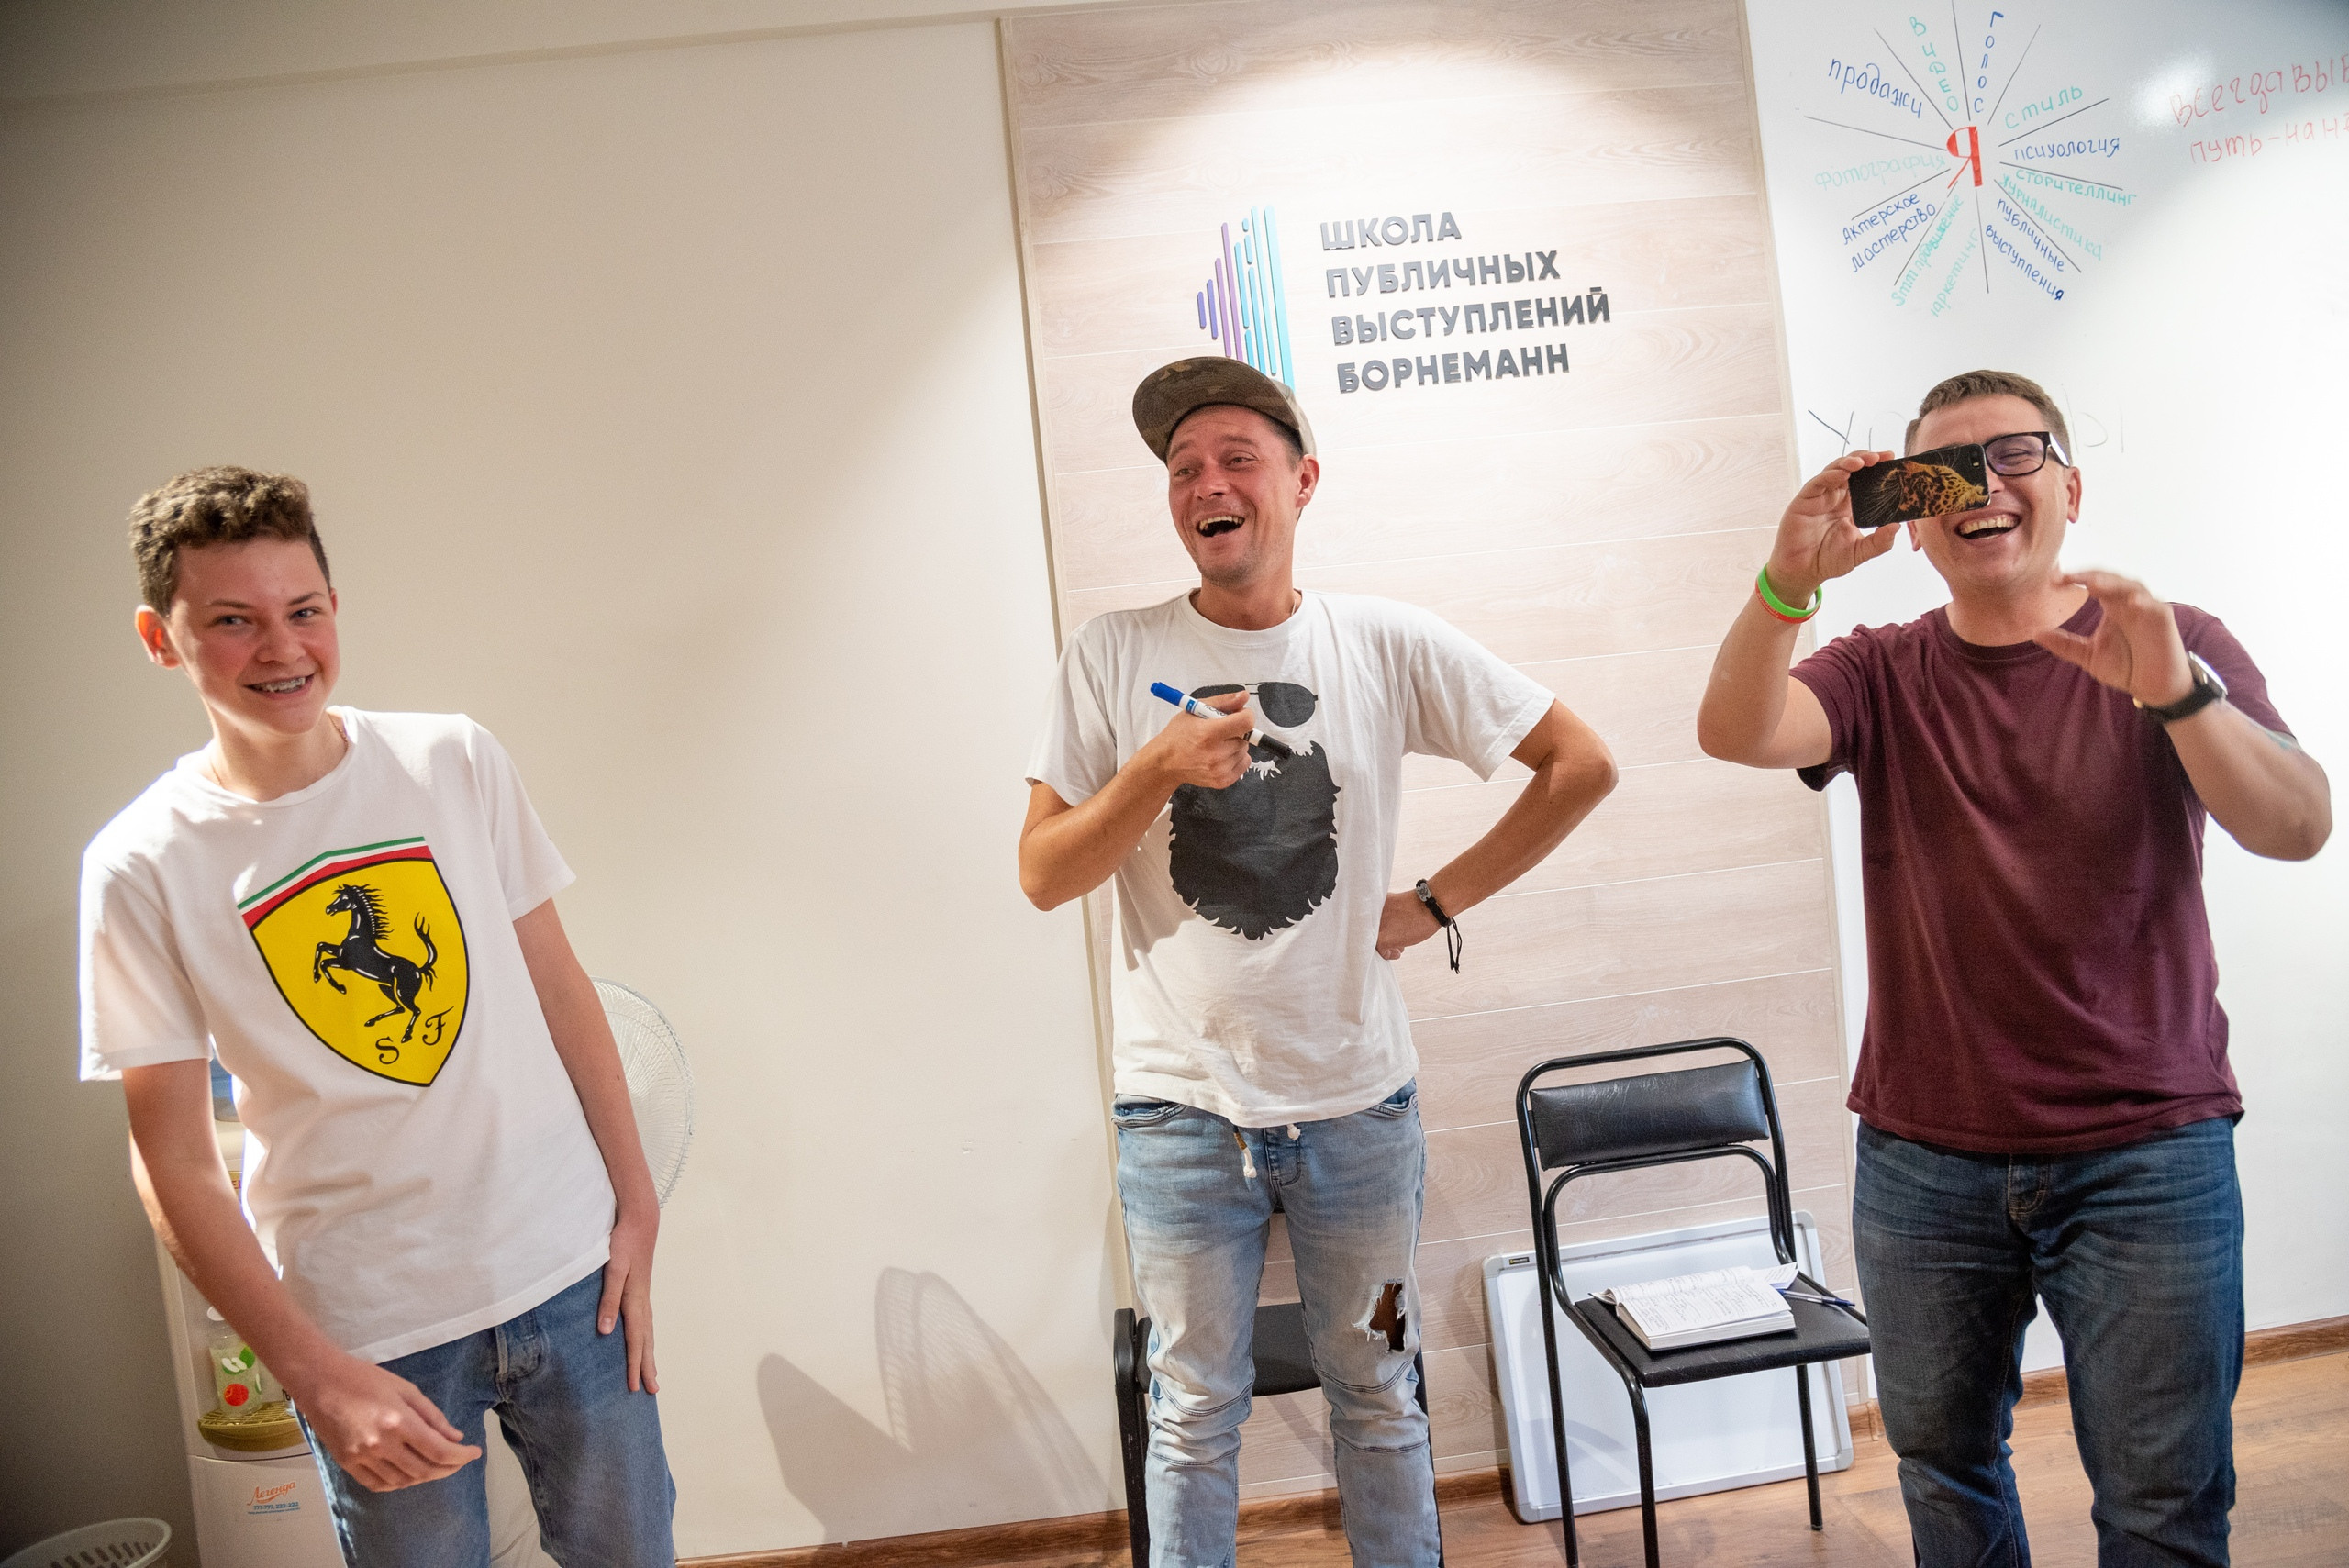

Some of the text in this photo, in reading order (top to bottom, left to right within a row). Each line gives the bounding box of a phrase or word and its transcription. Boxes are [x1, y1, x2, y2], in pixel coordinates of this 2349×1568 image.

[1828, 58, 1923, 119] продажи
[2004, 85, 2084, 129] стиль
[1946, 126, 1983, 189] Я
[1319, 211, 1463, 251] ШКОЛА
[1996, 198, 2065, 272] публичные
[1325, 250, 1561, 298] ПУБЛИЧНЫХ
[1985, 224, 2065, 301] выступления
[1330, 286, 1610, 346] ВЫСТУПЛЕНИЙ
[1336, 343, 1570, 394] БОРНЕМАНН
[374, 1006, 455, 1065] S F
